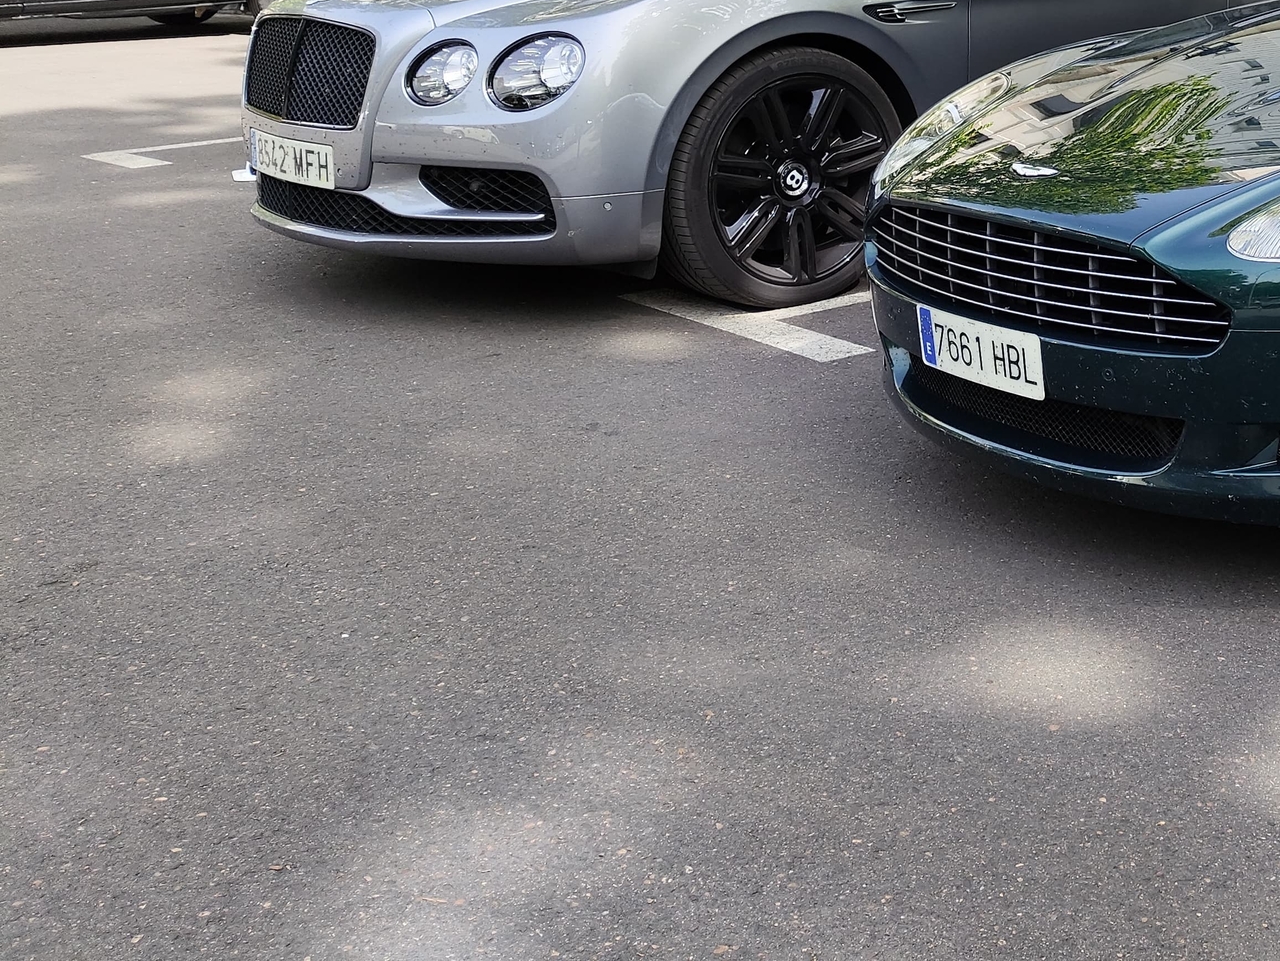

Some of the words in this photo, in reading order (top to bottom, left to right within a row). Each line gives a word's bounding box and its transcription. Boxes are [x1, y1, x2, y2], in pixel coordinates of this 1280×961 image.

[257, 137, 287, 173] 8542
[293, 146, 329, 182] MFH
[926, 342, 932, 355] E
[934, 322, 983, 371] 7661
[991, 340, 1038, 386] HBL
